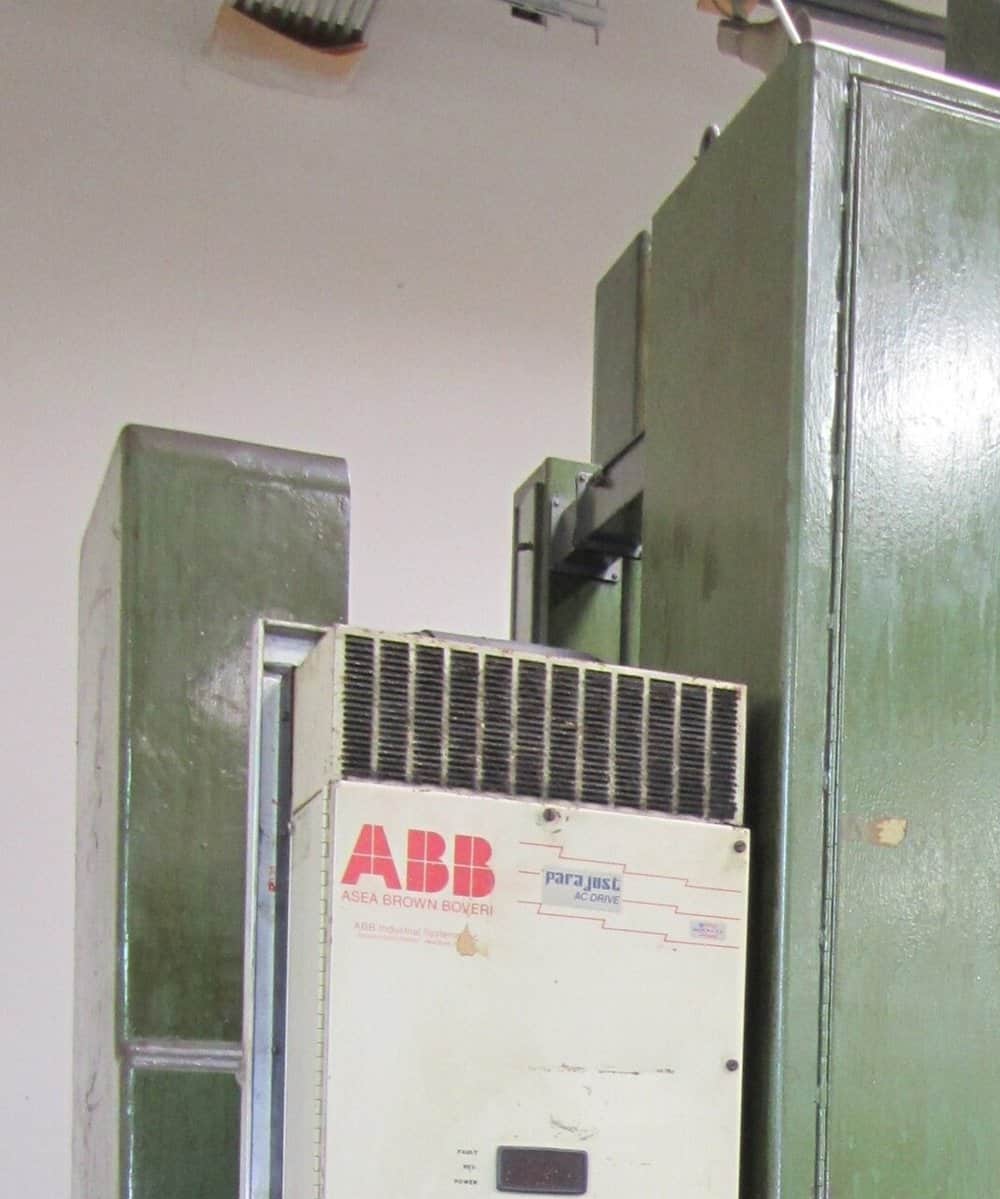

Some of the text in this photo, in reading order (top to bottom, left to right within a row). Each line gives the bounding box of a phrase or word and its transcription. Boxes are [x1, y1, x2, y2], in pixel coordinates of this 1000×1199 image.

[341, 824, 496, 898] ABB
[342, 889, 494, 917] ASEA BROWN BOVERI
[574, 891, 620, 905] AC DRIVE
[423, 927, 460, 941] System
